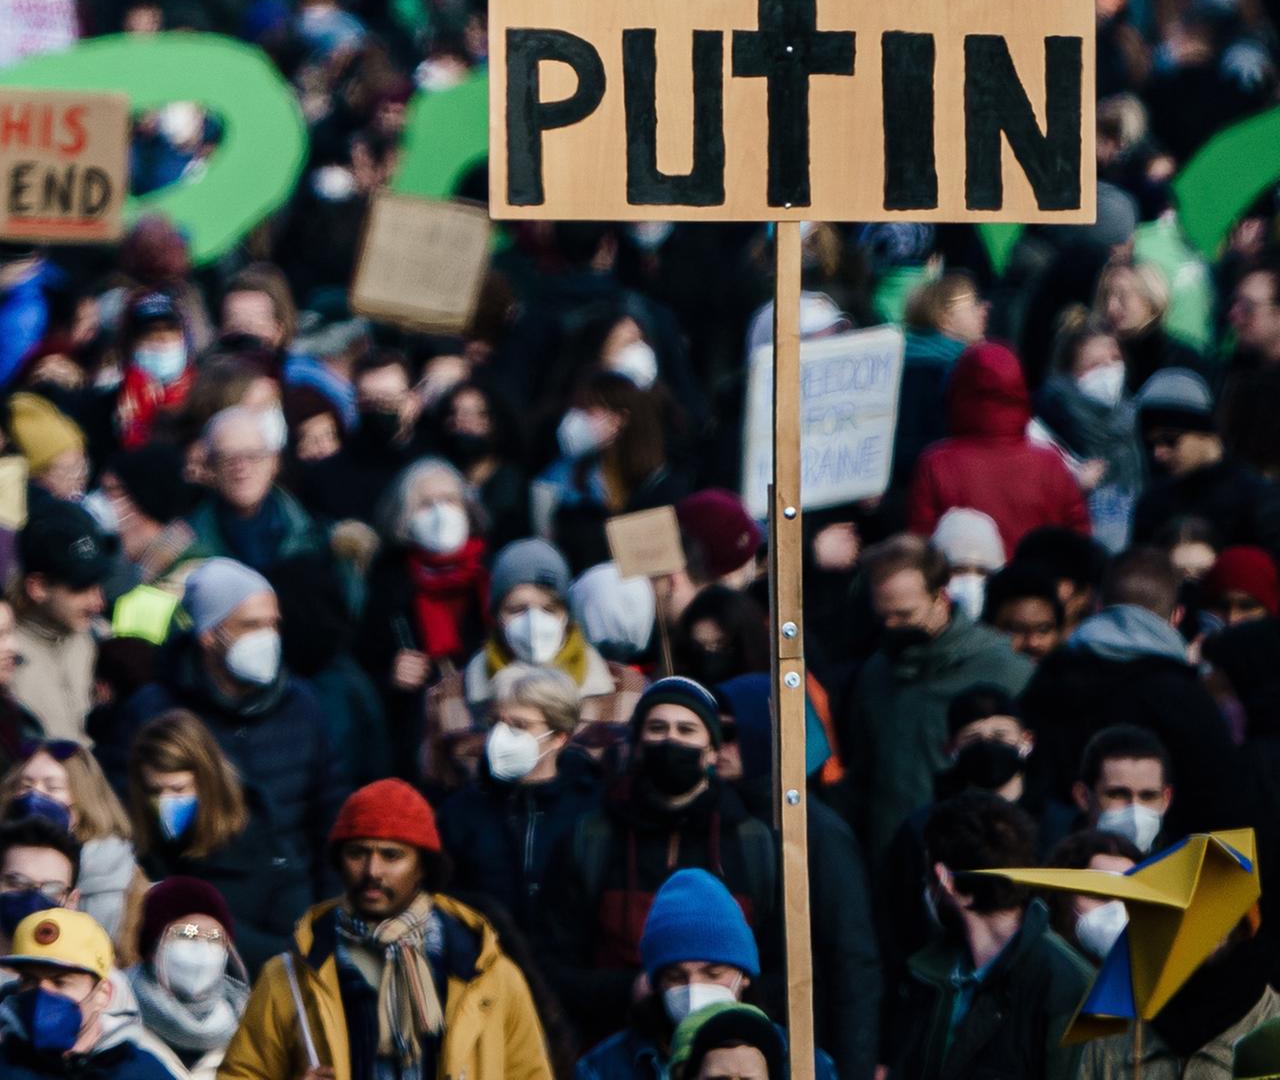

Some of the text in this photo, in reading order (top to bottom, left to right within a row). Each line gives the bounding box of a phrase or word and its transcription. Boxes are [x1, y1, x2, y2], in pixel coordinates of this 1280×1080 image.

[506, 28, 1082, 211] PUTIN
[7, 161, 113, 220] END
[806, 401, 856, 438] FOR
